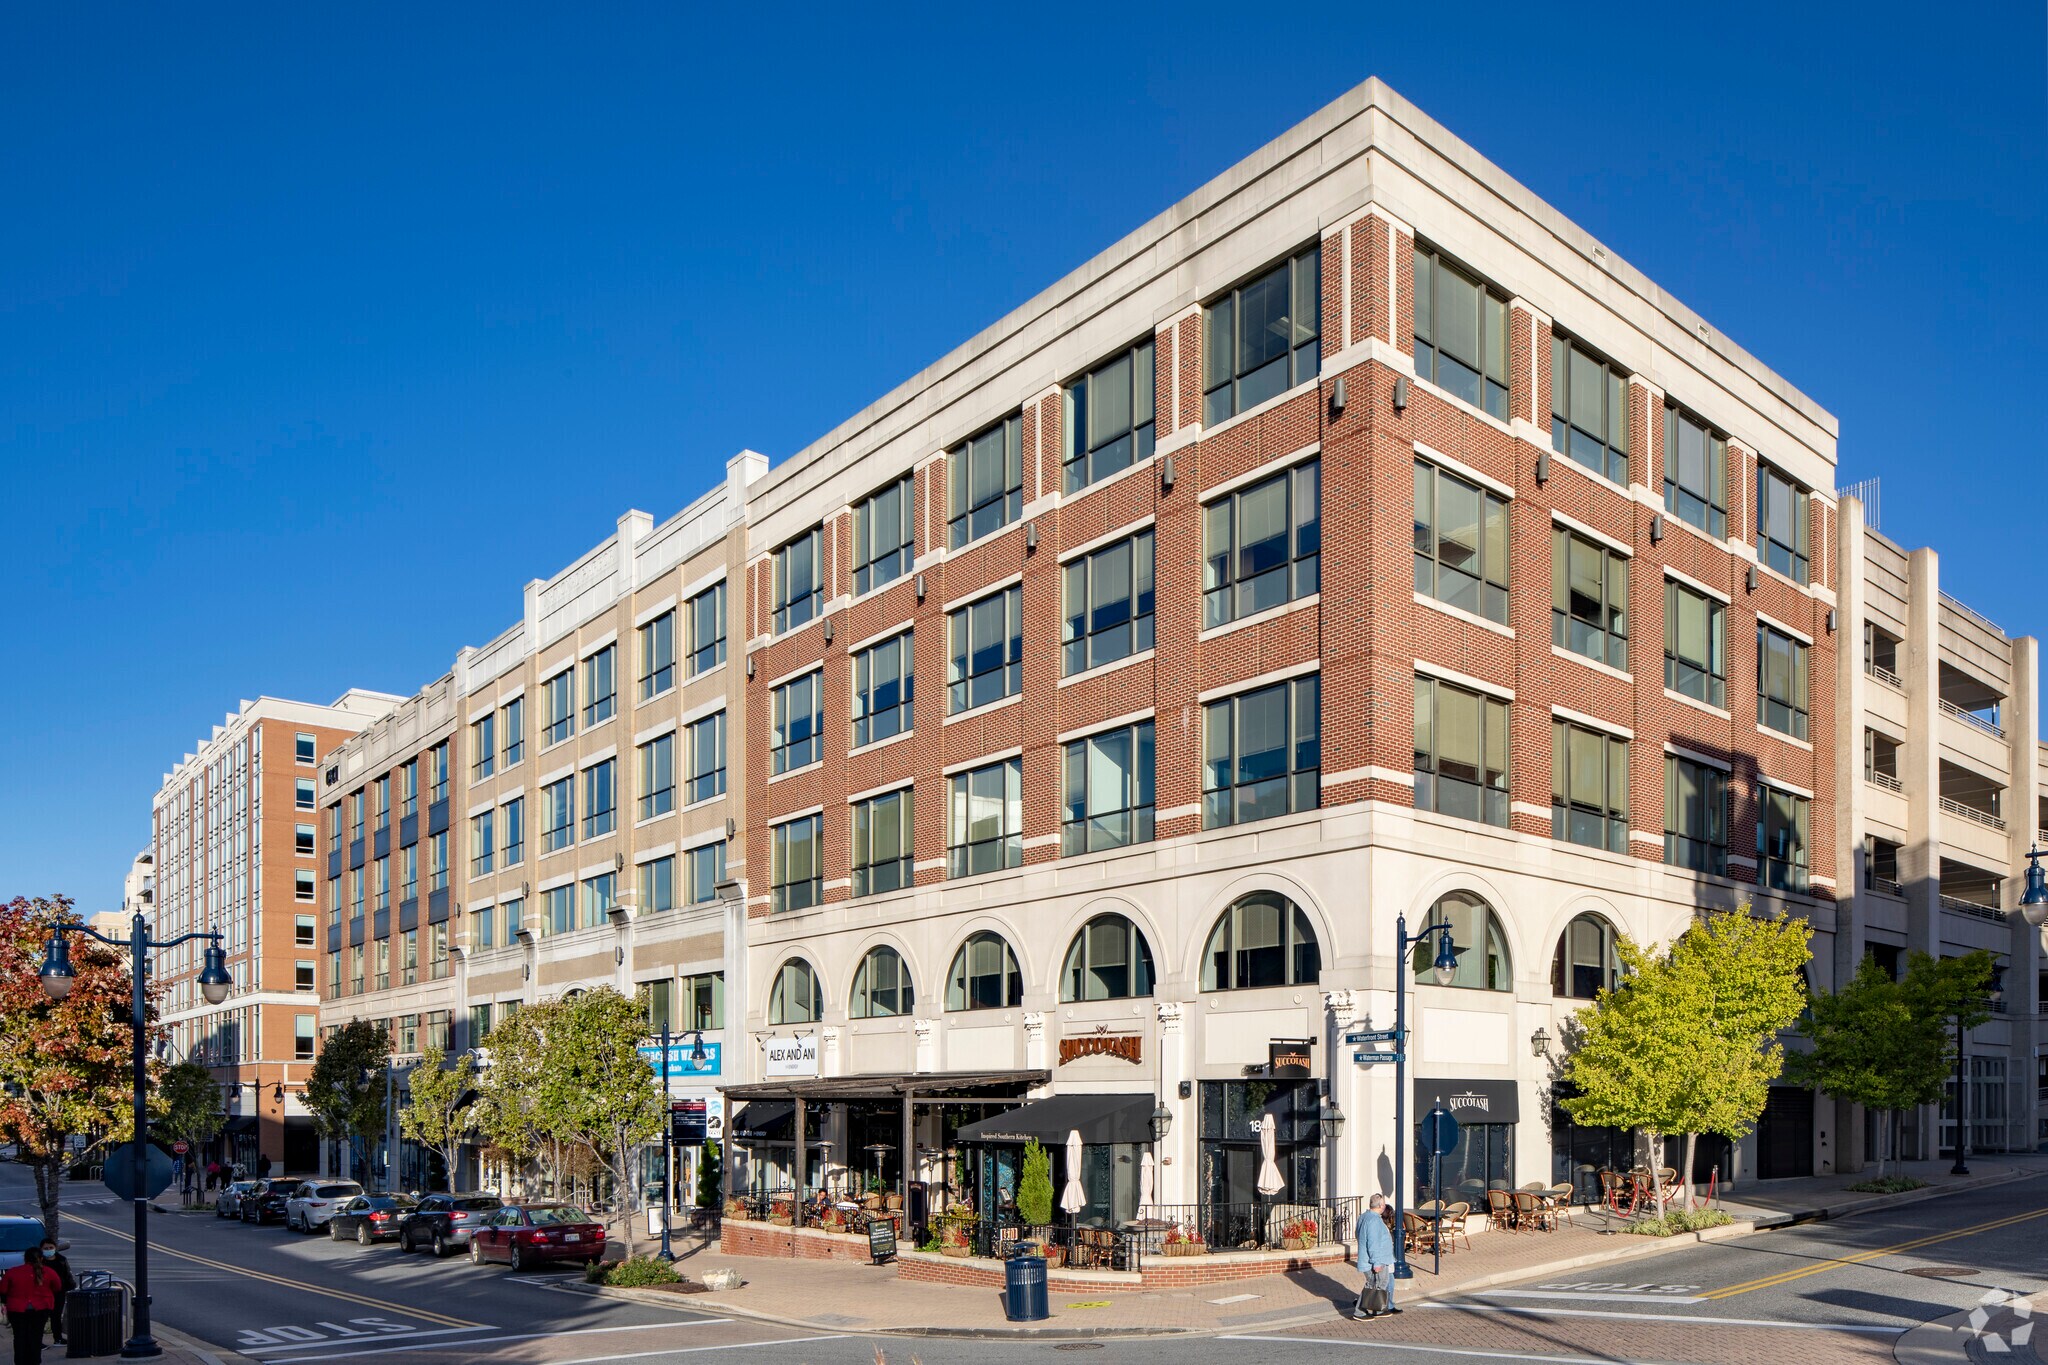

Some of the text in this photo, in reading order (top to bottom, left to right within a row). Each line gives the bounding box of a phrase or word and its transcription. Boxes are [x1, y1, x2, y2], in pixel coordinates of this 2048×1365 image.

[1356, 1033, 1389, 1042] Waterfront Street
[681, 1047, 716, 1061] WARS
[769, 1047, 815, 1061] ALEX AND ANI
[1059, 1037, 1142, 1067] SUCCOTASH
[1380, 1054, 1393, 1062] Passage
[1275, 1057, 1310, 1069] SUCCOTASH
[1449, 1097, 1489, 1112] SUCCOTASH
[980, 1132, 1032, 1141] Inspired Southern Kitchen
[173, 1143, 188, 1151] STOP
[1538, 1282, 1700, 1293] STOP
[237, 1317, 416, 1345] STOP
